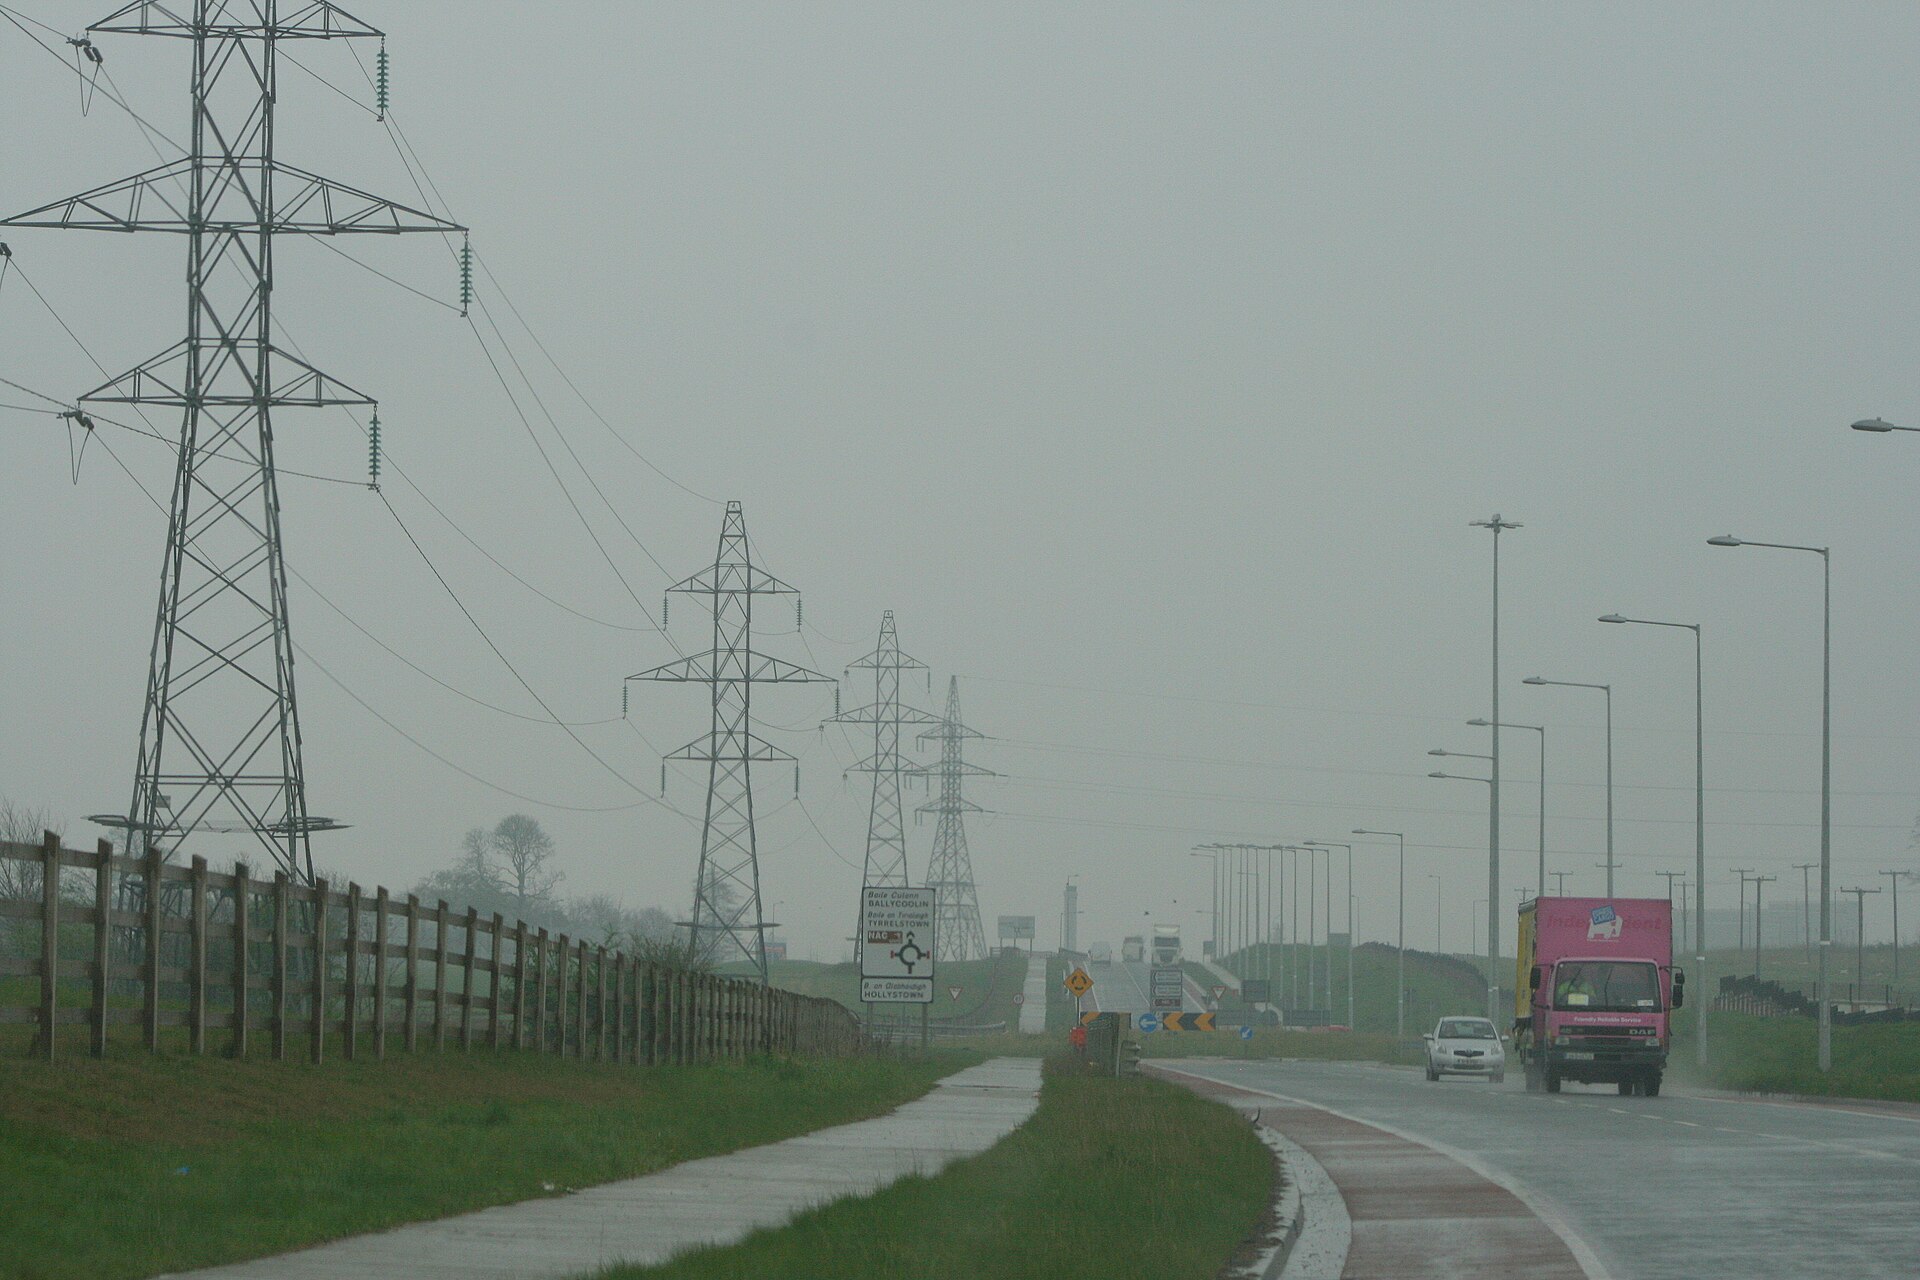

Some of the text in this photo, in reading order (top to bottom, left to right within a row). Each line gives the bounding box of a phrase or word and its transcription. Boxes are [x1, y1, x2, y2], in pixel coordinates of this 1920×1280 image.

[869, 900, 928, 908] BALLYCOOLIN
[869, 919, 929, 927] TYRRELSTOWN
[864, 990, 924, 998] HOLLYSTOWN
[1574, 1016, 1596, 1024] Friendly
